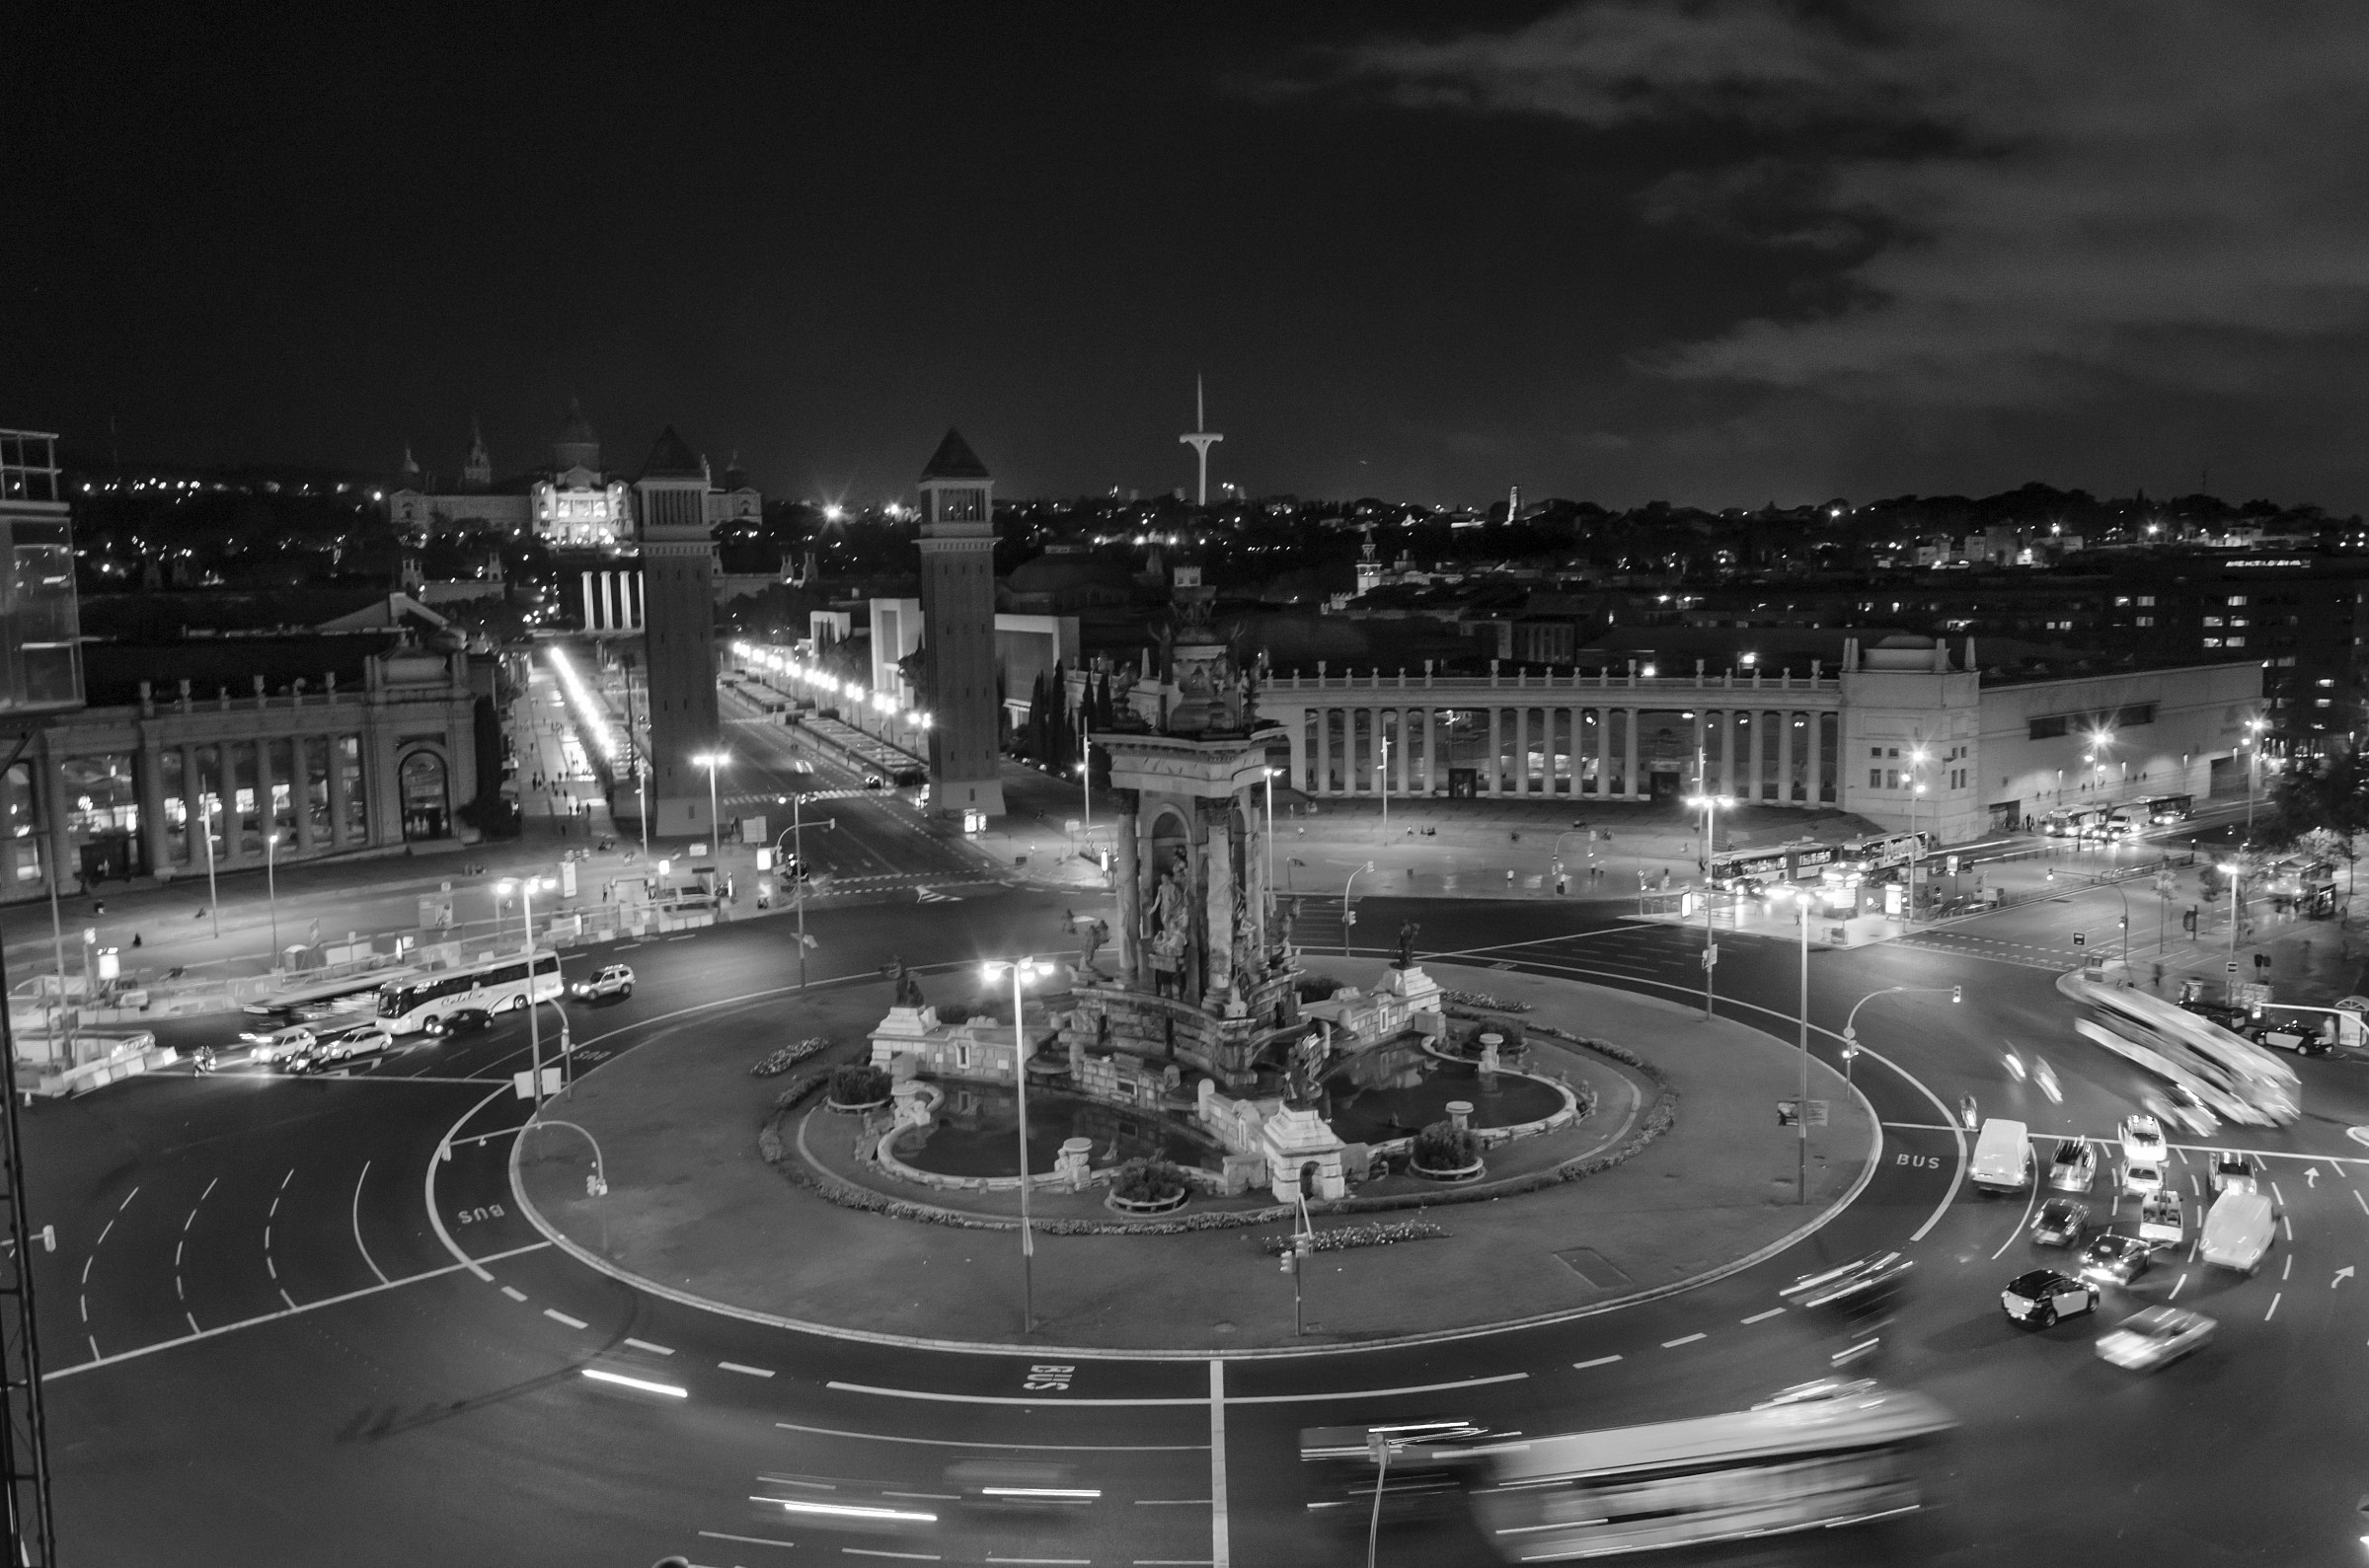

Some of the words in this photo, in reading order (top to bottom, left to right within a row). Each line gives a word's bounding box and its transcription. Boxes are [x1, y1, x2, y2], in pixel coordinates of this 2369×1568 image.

[1896, 1153, 1941, 1169] BUS
[458, 1204, 505, 1224] BUS
[1023, 1365, 1076, 1390] BUS
